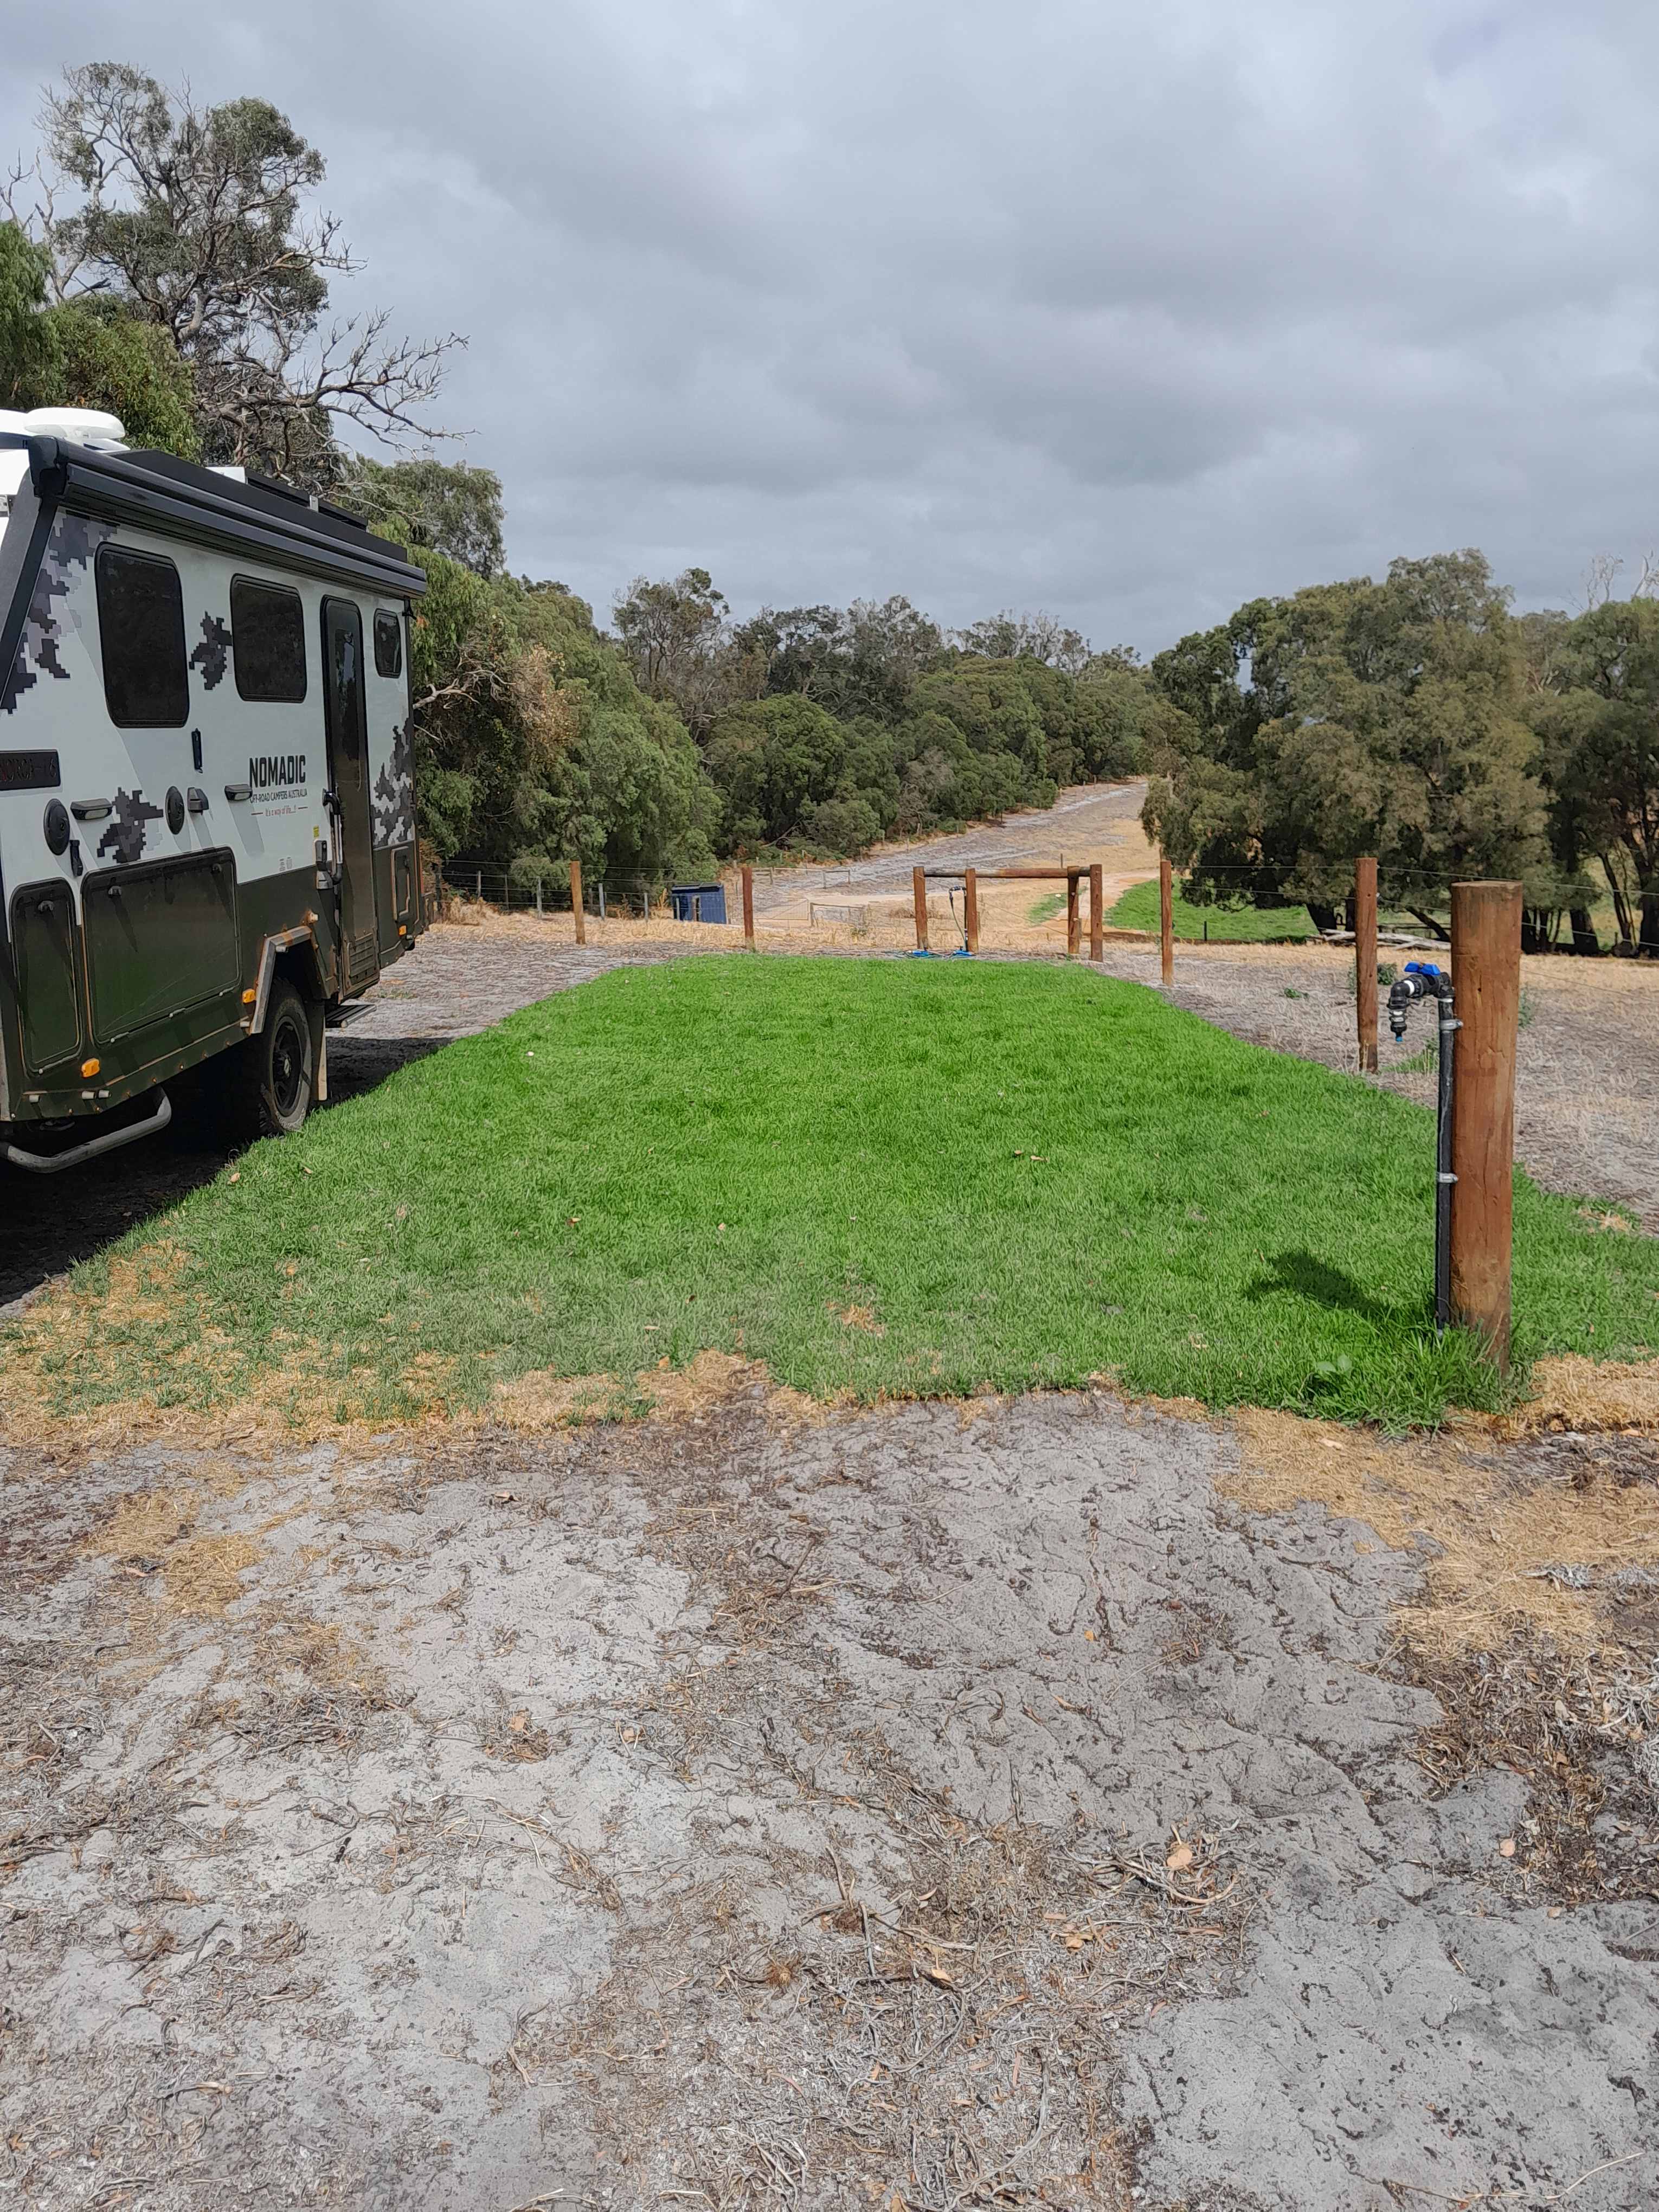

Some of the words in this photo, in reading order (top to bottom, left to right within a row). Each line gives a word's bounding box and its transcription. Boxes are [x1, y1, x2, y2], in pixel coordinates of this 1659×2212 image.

[249, 755, 306, 788] NOMADIC
[271, 790, 287, 801] CAMPERS
[288, 788, 307, 799] AUSTRALIA
